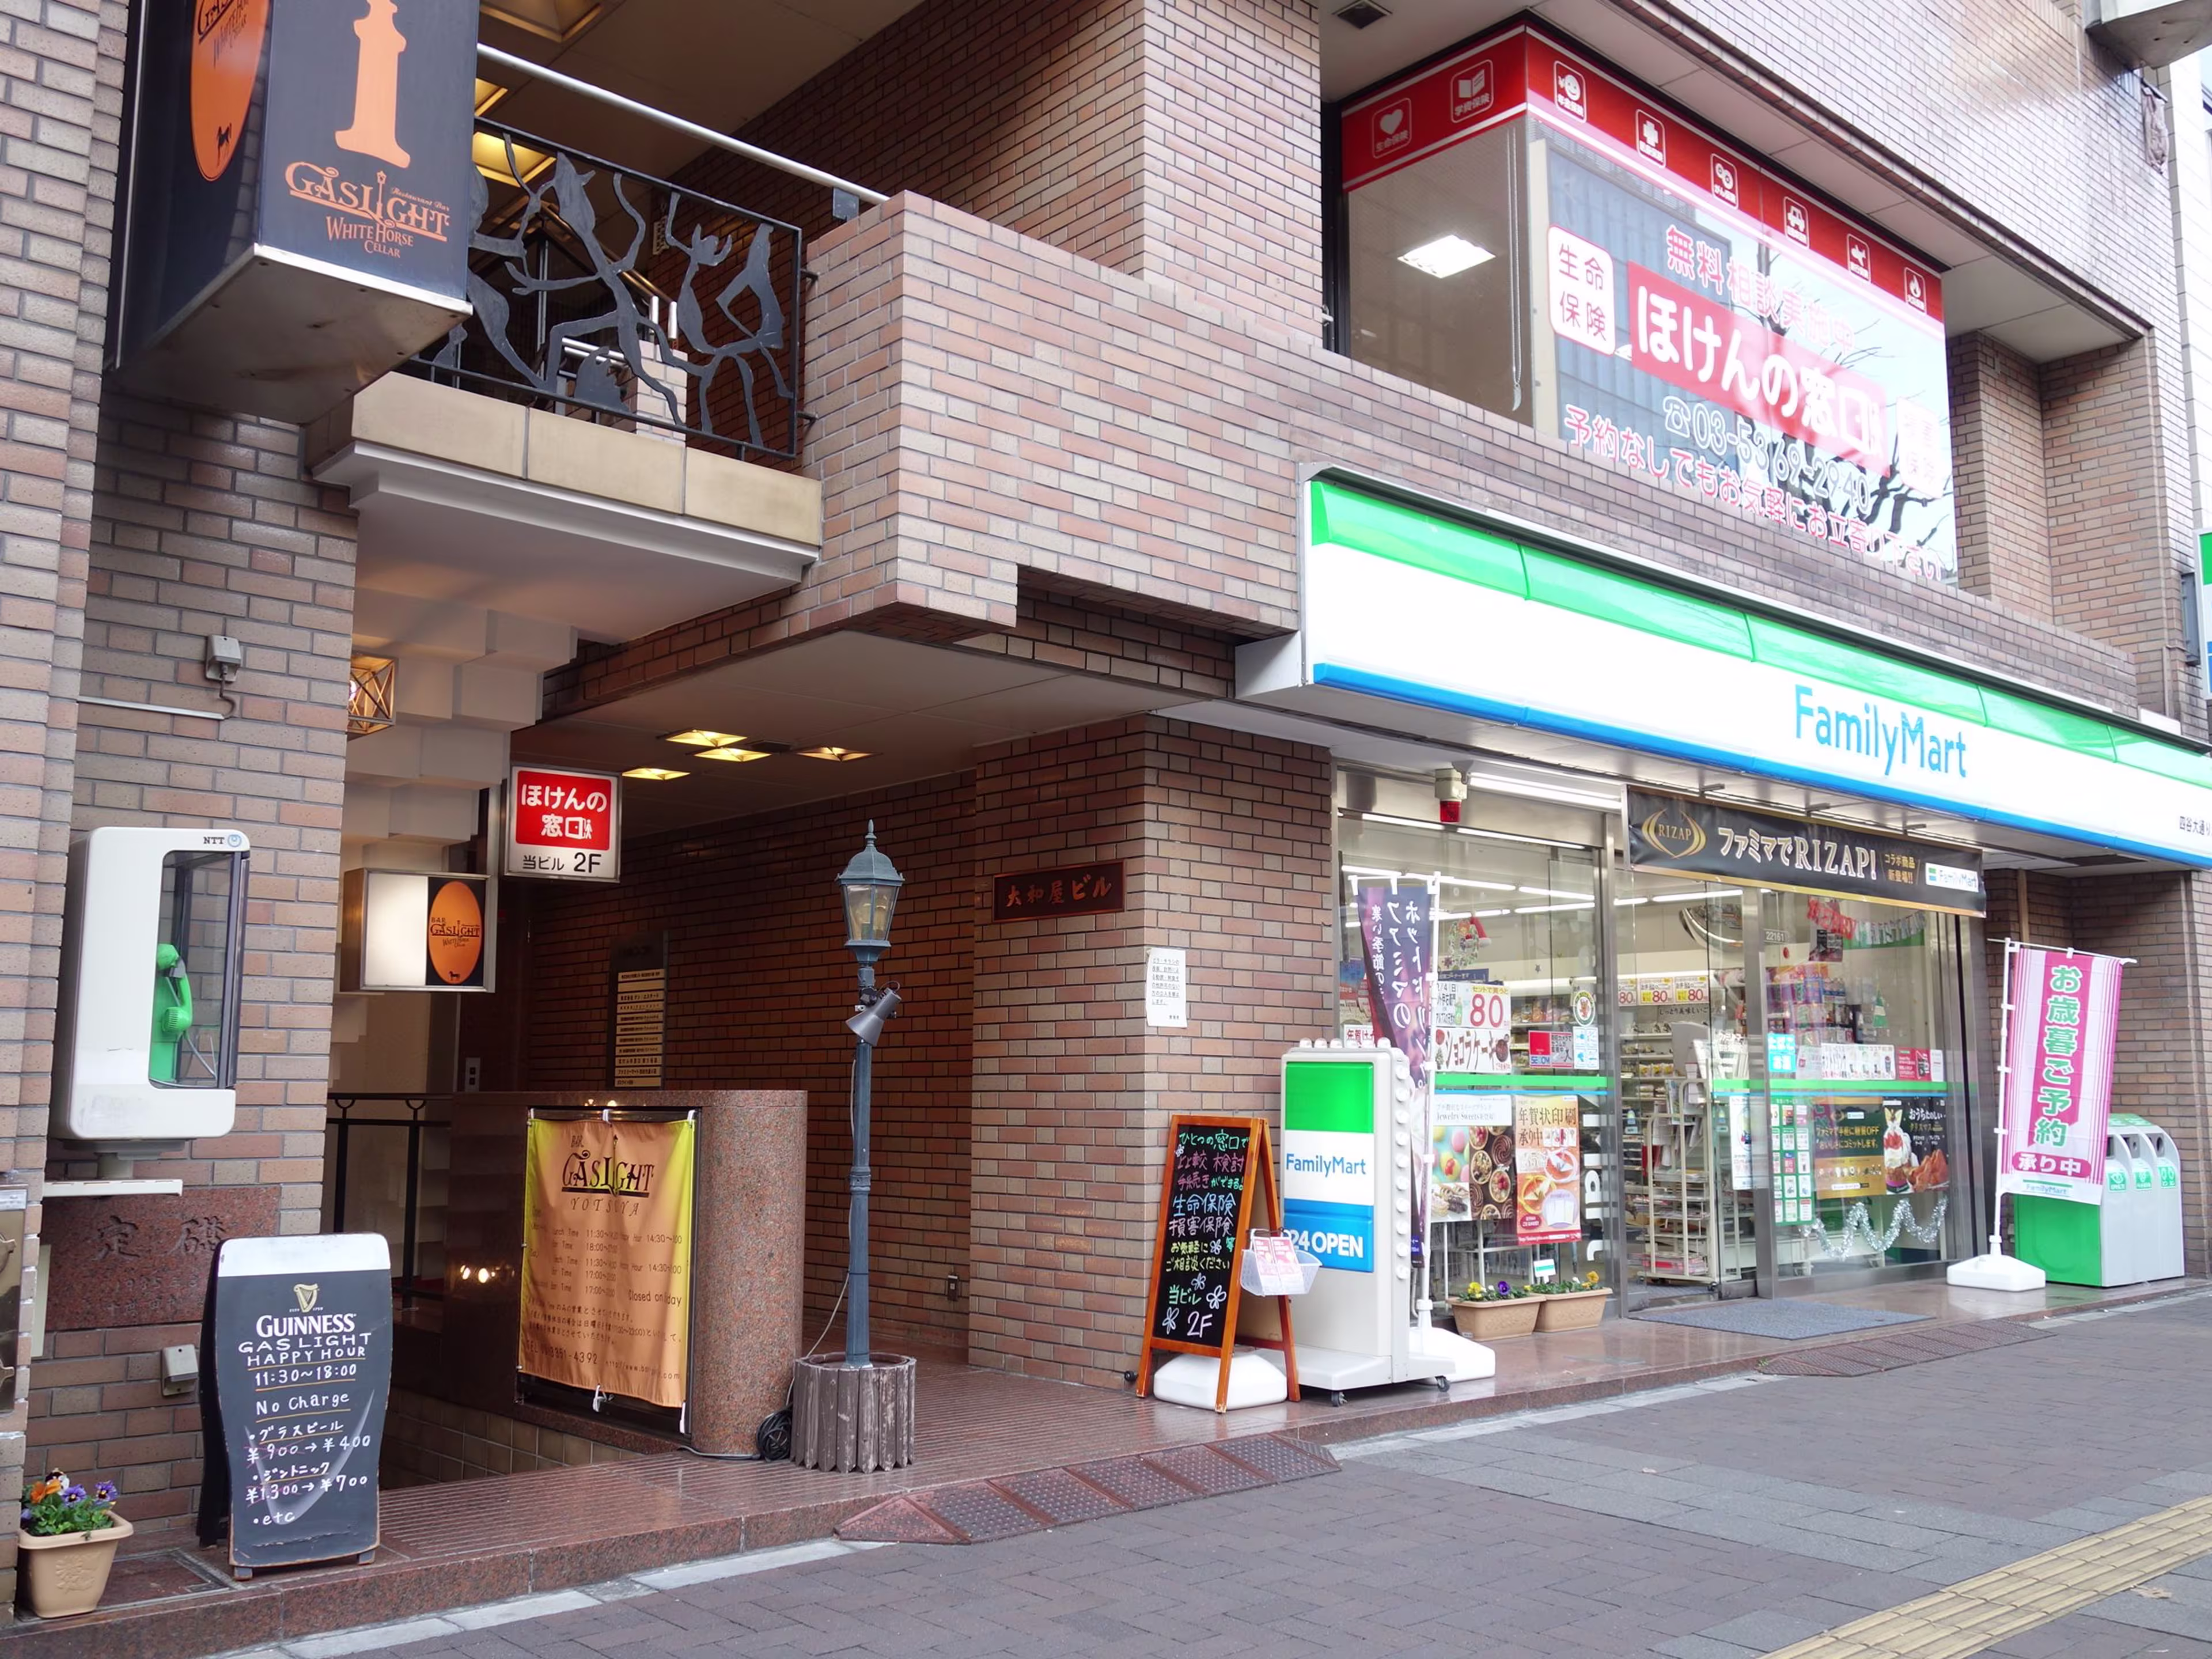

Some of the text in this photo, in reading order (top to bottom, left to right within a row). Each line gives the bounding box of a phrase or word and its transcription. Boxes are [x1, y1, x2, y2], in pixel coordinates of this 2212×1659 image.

[325, 215, 414, 247] WHITE HORSE
[363, 238, 401, 259] CELLAR
[1558, 243, 1605, 291] 生命
[1558, 290, 1607, 342] 保険
[1794, 683, 1967, 778] FamilyMart
[520, 783, 608, 813] ほけんの
[203, 836, 225, 845] NTT
[1658, 824, 1692, 840] RIZAP
[522, 852, 602, 873] 当ビル 2F
[1006, 873, 1112, 908] 大和屋ビル
[1652, 990, 1668, 1002] 80
[1470, 994, 1504, 1028] 80
[2034, 964, 2082, 1149] お歳暮ご予約
[1518, 1106, 1577, 1126] 年賀状印刷
[1179, 1129, 1250, 1152] ひとつの窓口で
[1286, 1153, 1366, 1177] FamilyMart
[2018, 1153, 2082, 1176] 承り中
[2026, 1184, 2067, 1194] FamilyMart
[1172, 1192, 1237, 1217] 生命保険
[1168, 1215, 1234, 1238] 損害保険
[1165, 1255, 1230, 1272] ご相談ください
[628, 1290, 652, 1303] Closed
[1168, 1283, 1202, 1305] 当ビル
[256, 1313, 355, 1338] GUINNESS
[1187, 1310, 1213, 1338] 2F
[247, 1346, 366, 1368] HAPPY HOUR
[256, 1393, 350, 1415] No Charge
